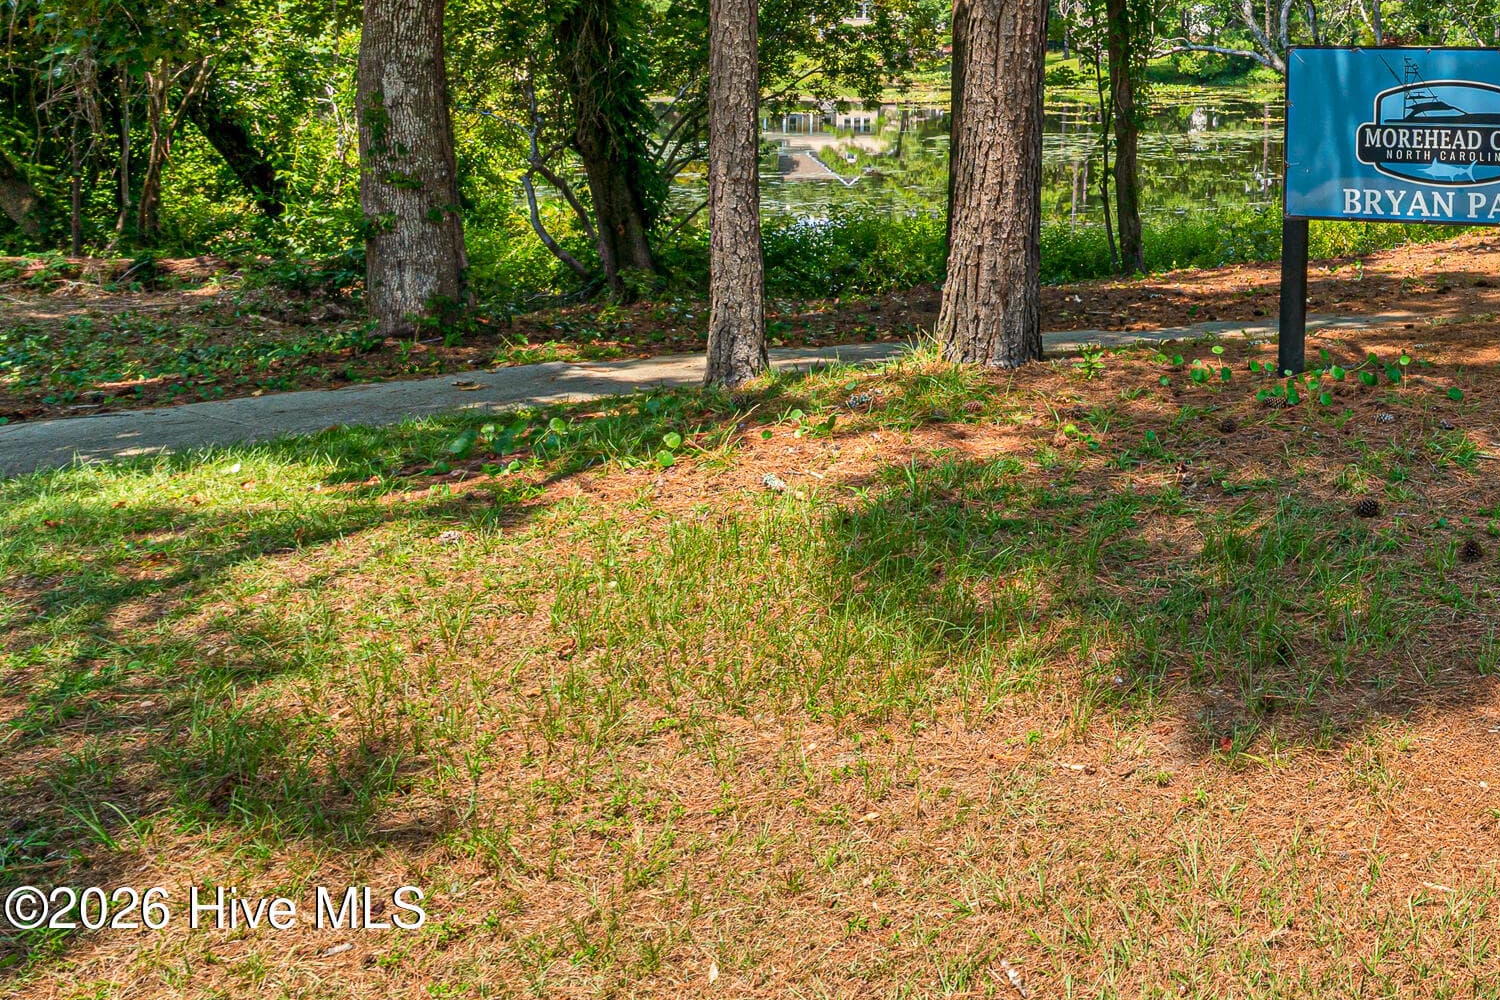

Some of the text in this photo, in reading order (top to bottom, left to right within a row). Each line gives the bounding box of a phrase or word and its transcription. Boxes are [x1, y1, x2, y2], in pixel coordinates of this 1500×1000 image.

[1365, 128, 1482, 150] MOREHEAD
[1386, 149, 1431, 161] NORTH
[1342, 188, 1455, 217] BRYAN
